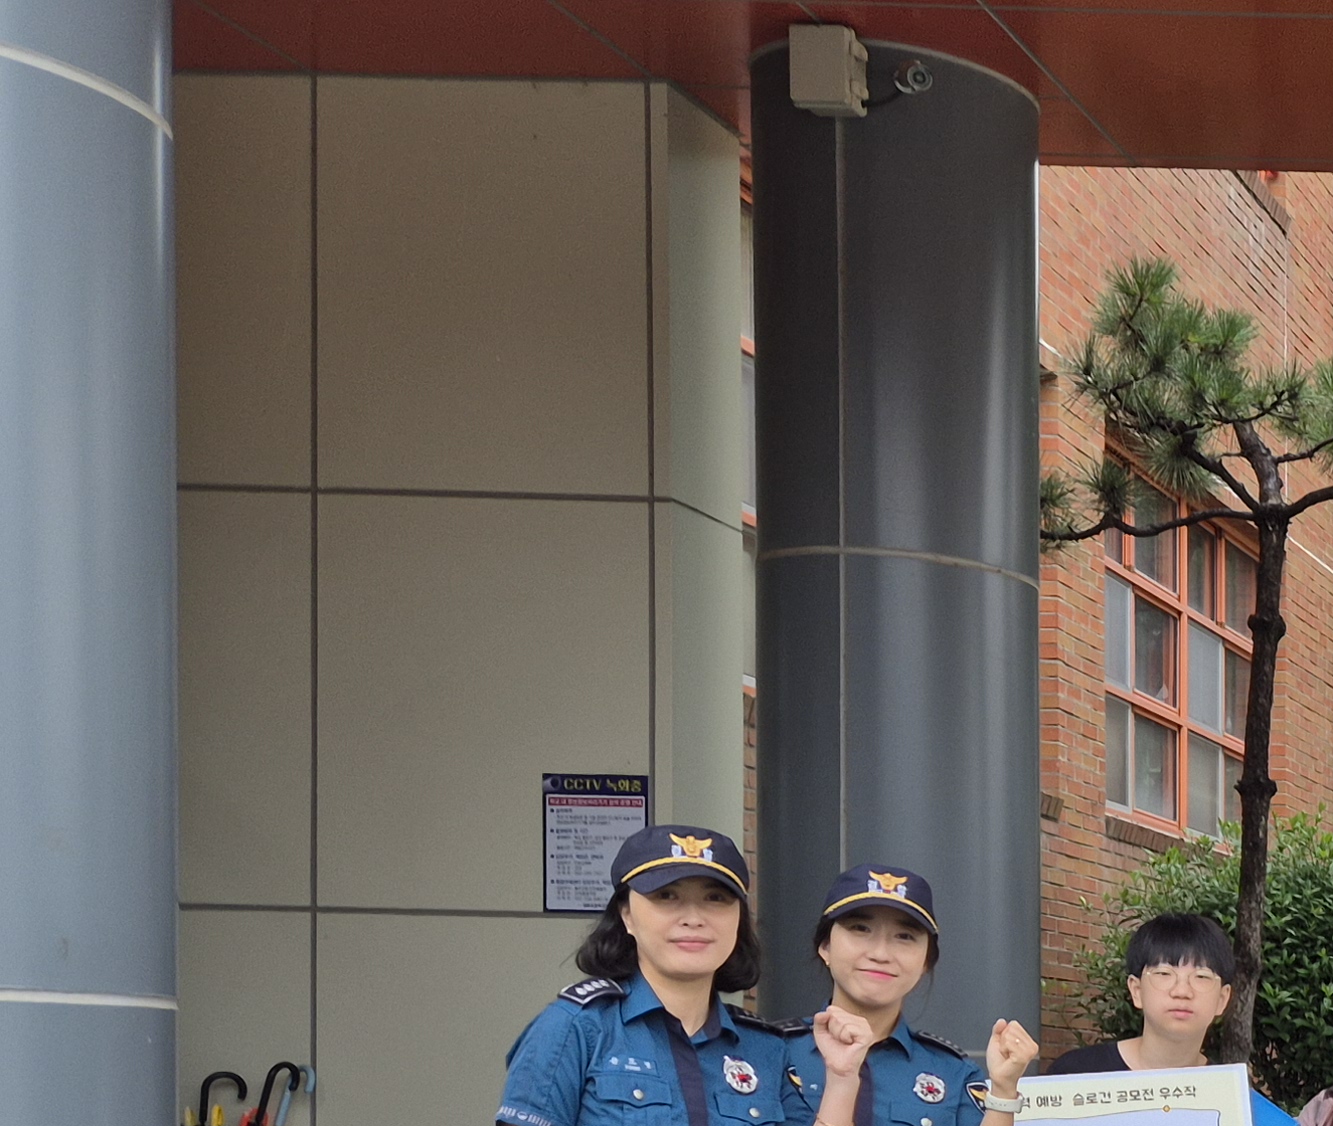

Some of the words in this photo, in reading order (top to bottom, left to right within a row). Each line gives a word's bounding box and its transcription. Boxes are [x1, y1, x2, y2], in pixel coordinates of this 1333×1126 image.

[563, 778, 602, 791] CCTV
[1036, 1095, 1062, 1108] 예방
[1073, 1092, 1112, 1107] 슬로건
[1117, 1088, 1155, 1103] 공모전
[1159, 1085, 1196, 1100] 우수작
